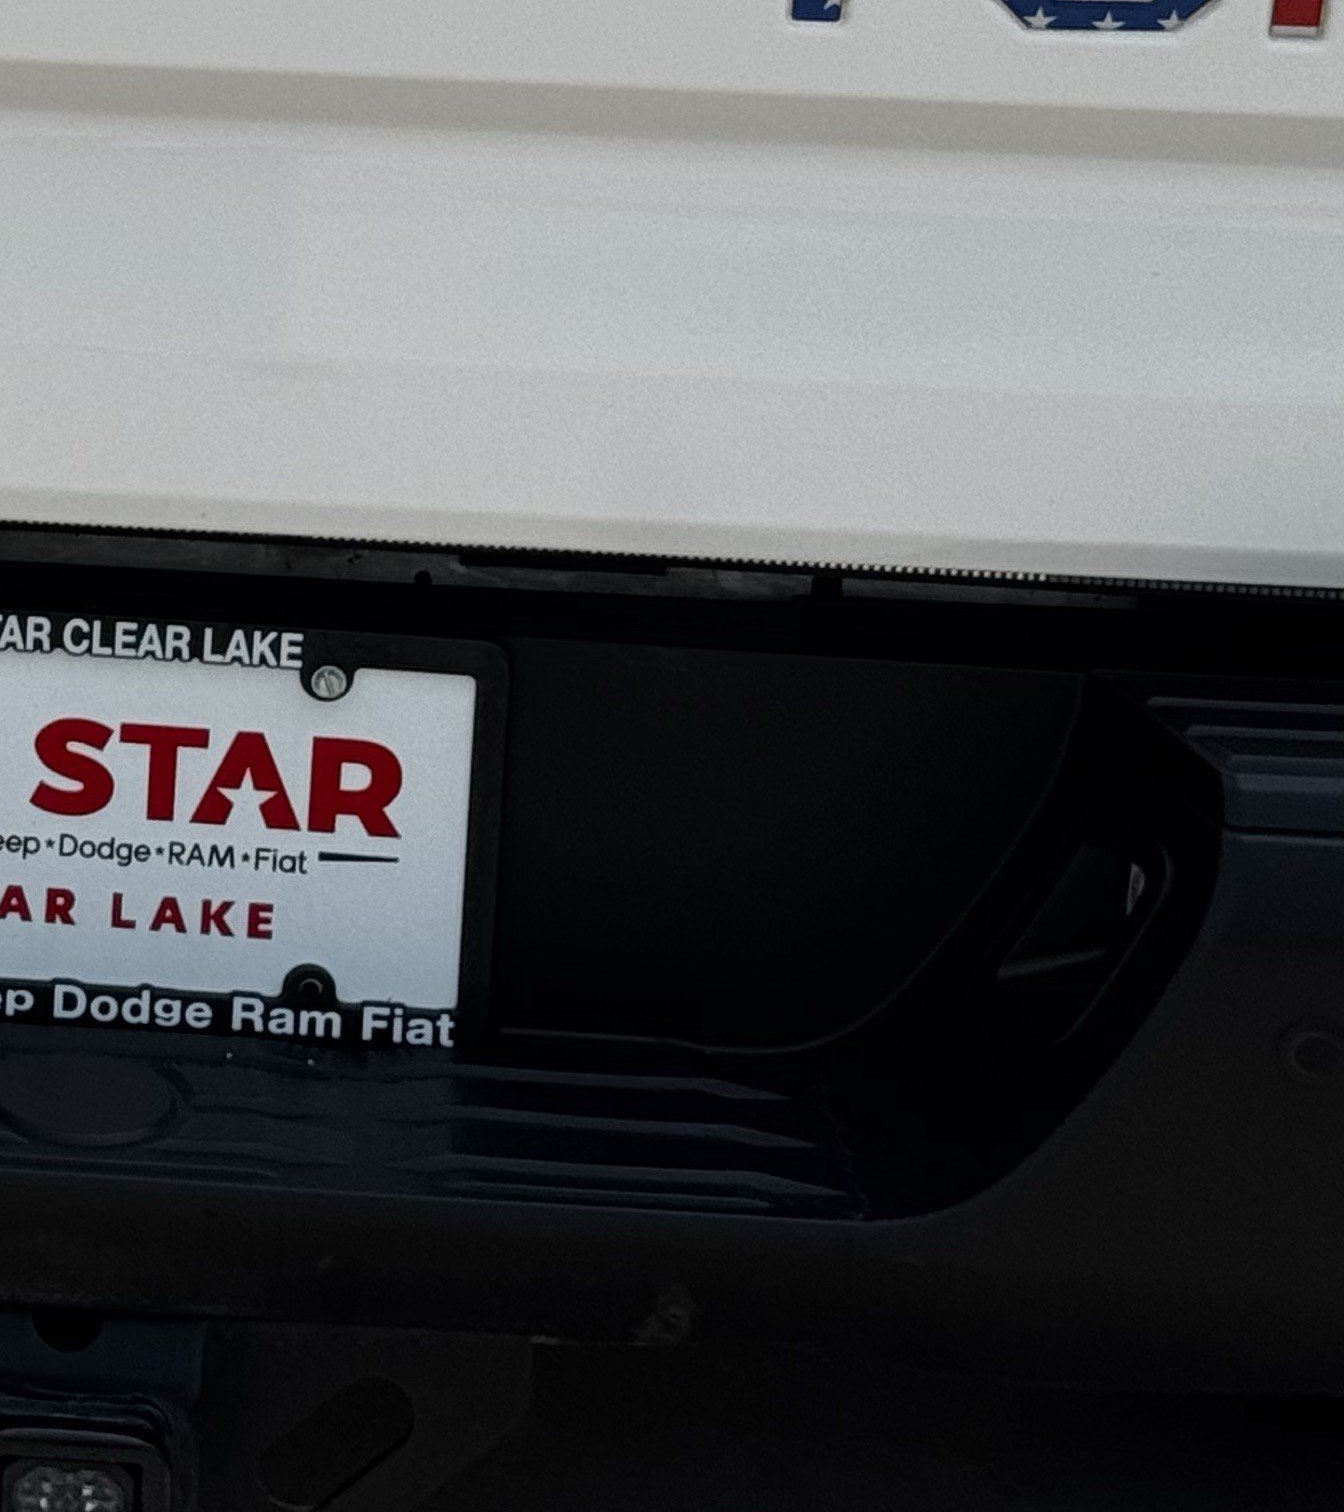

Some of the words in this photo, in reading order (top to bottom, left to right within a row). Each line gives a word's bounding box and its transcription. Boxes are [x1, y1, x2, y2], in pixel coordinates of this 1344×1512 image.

[62, 617, 191, 662] CLEAR
[202, 626, 304, 669] LAKE
[29, 717, 404, 839] STAR
[58, 833, 152, 867] Dodge
[168, 840, 236, 870] RAM
[254, 847, 309, 875] Fiat
[110, 891, 275, 940] LAKE
[52, 984, 213, 1031] Dodge
[230, 998, 342, 1040] Ram
[360, 1006, 456, 1049] Fiat
